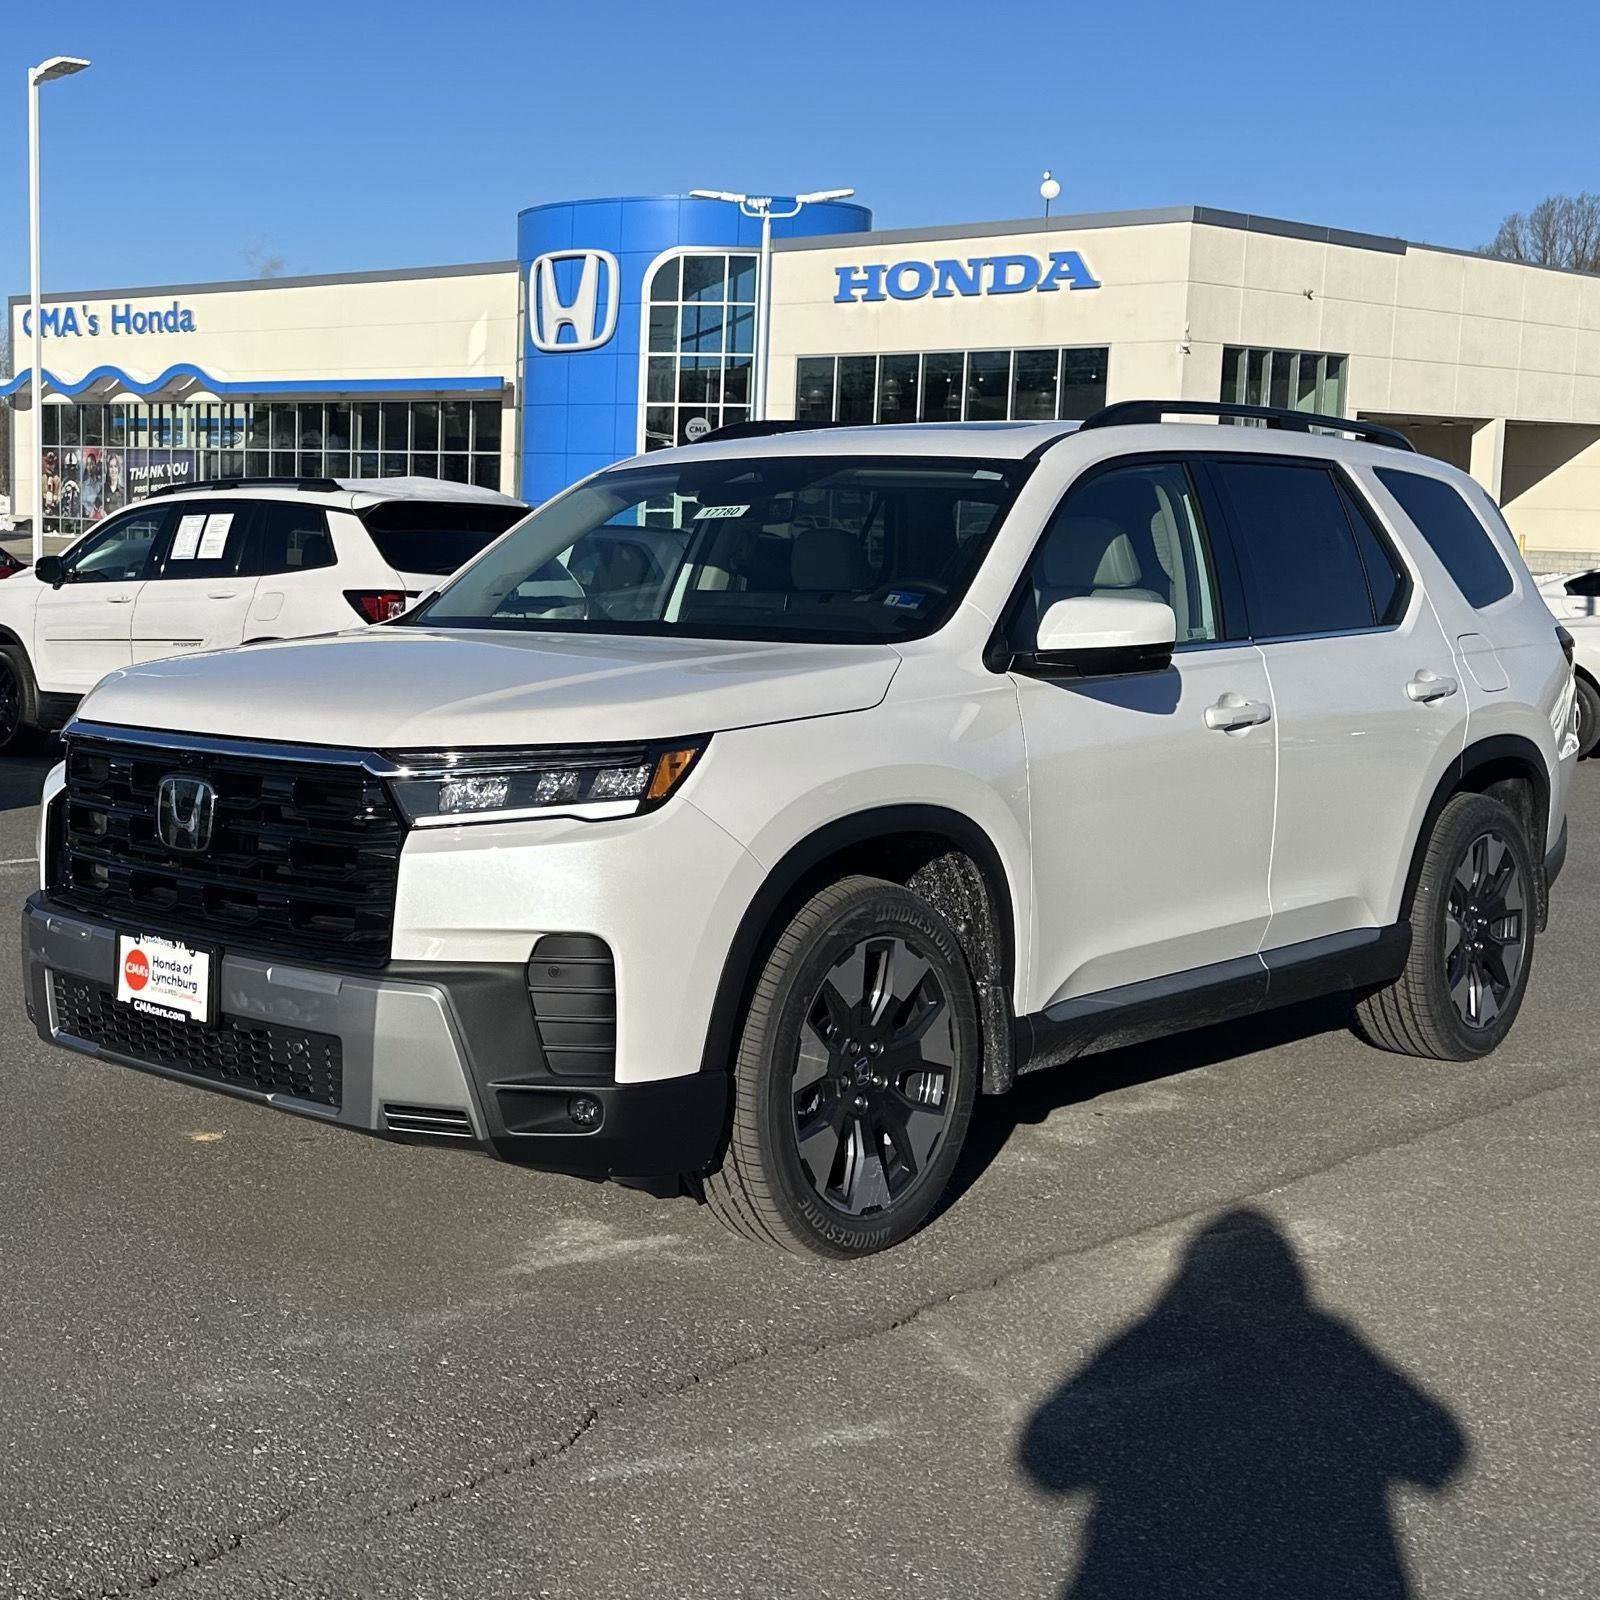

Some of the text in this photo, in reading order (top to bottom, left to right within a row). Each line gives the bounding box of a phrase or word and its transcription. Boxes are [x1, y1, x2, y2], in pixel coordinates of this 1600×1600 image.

[834, 250, 1101, 303] HONDA
[111, 301, 196, 335] Honda
[129, 461, 189, 481] THANK YOU
[704, 506, 741, 517] 17780
[152, 955, 193, 976] Honda of
[151, 969, 198, 994] Lynchburg
[133, 1000, 186, 1022] CMAcars.com
